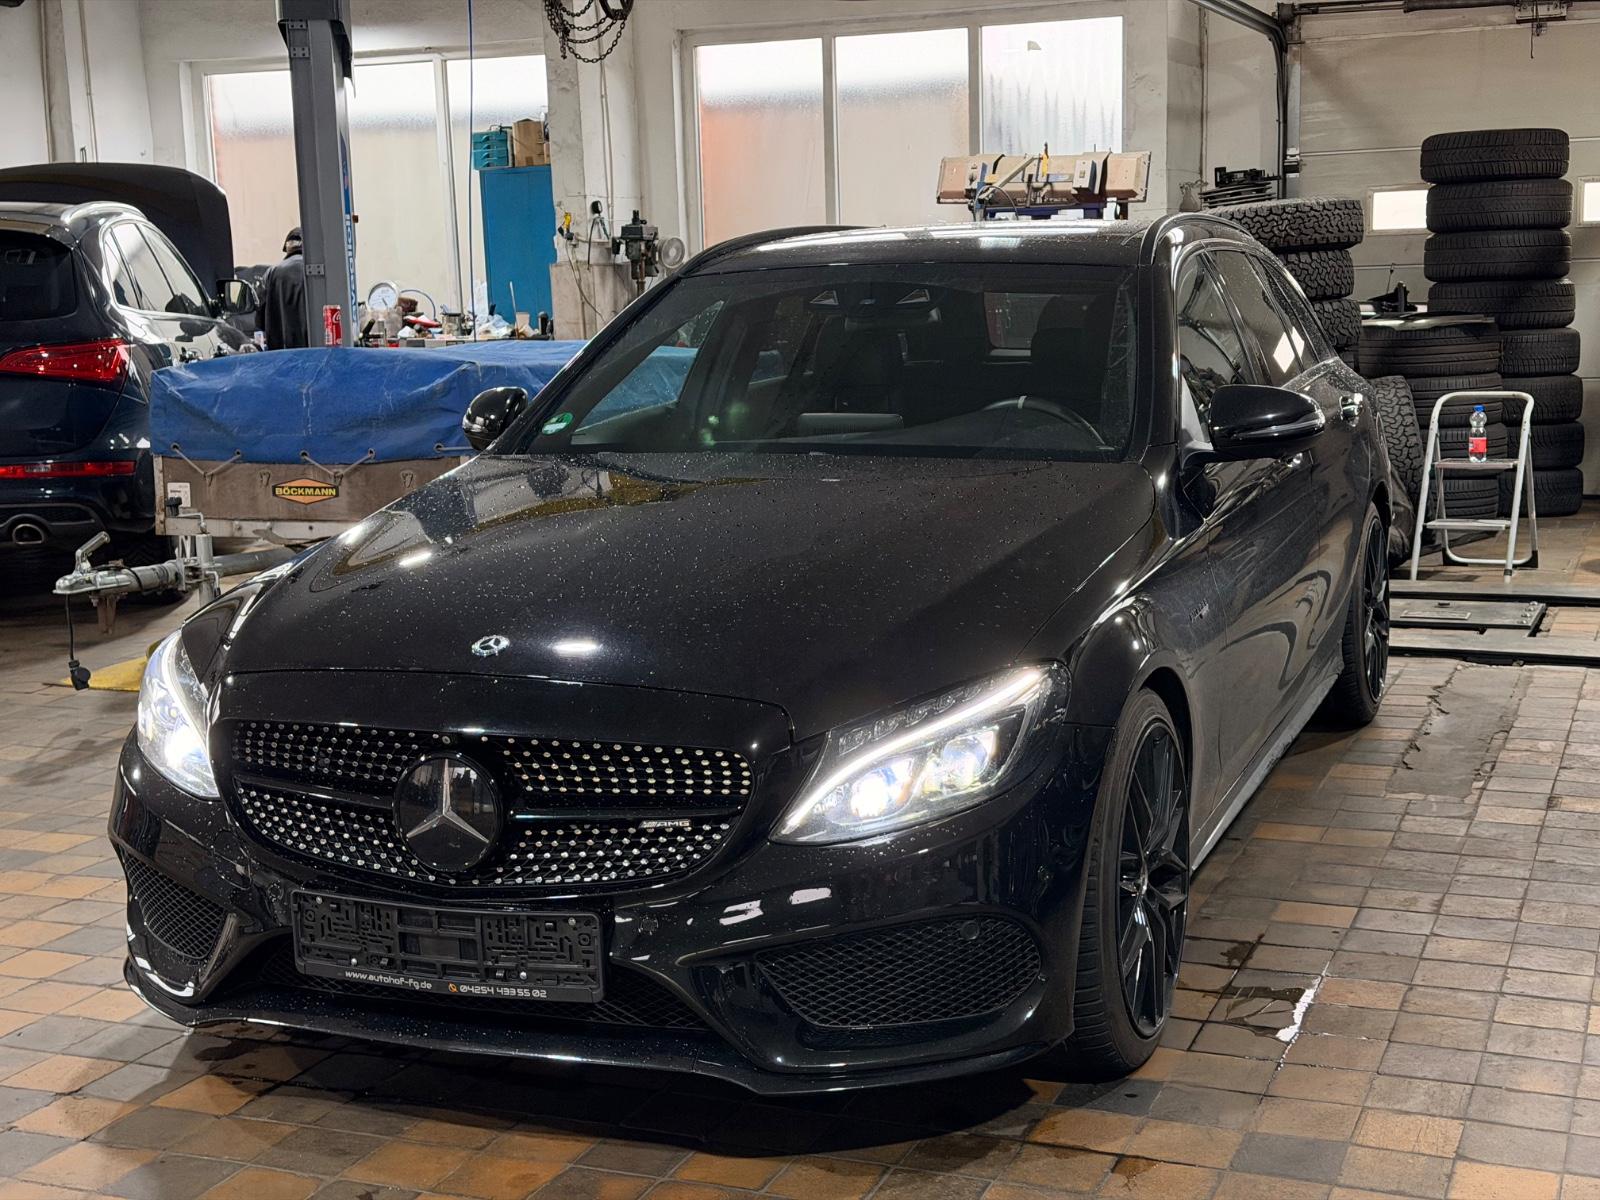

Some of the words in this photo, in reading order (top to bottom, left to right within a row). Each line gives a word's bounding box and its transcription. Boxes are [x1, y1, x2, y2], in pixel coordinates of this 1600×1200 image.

[275, 486, 336, 496] BÖCKMANN
[345, 971, 432, 989] www.autohof-fg.de
[460, 984, 495, 995] 04254
